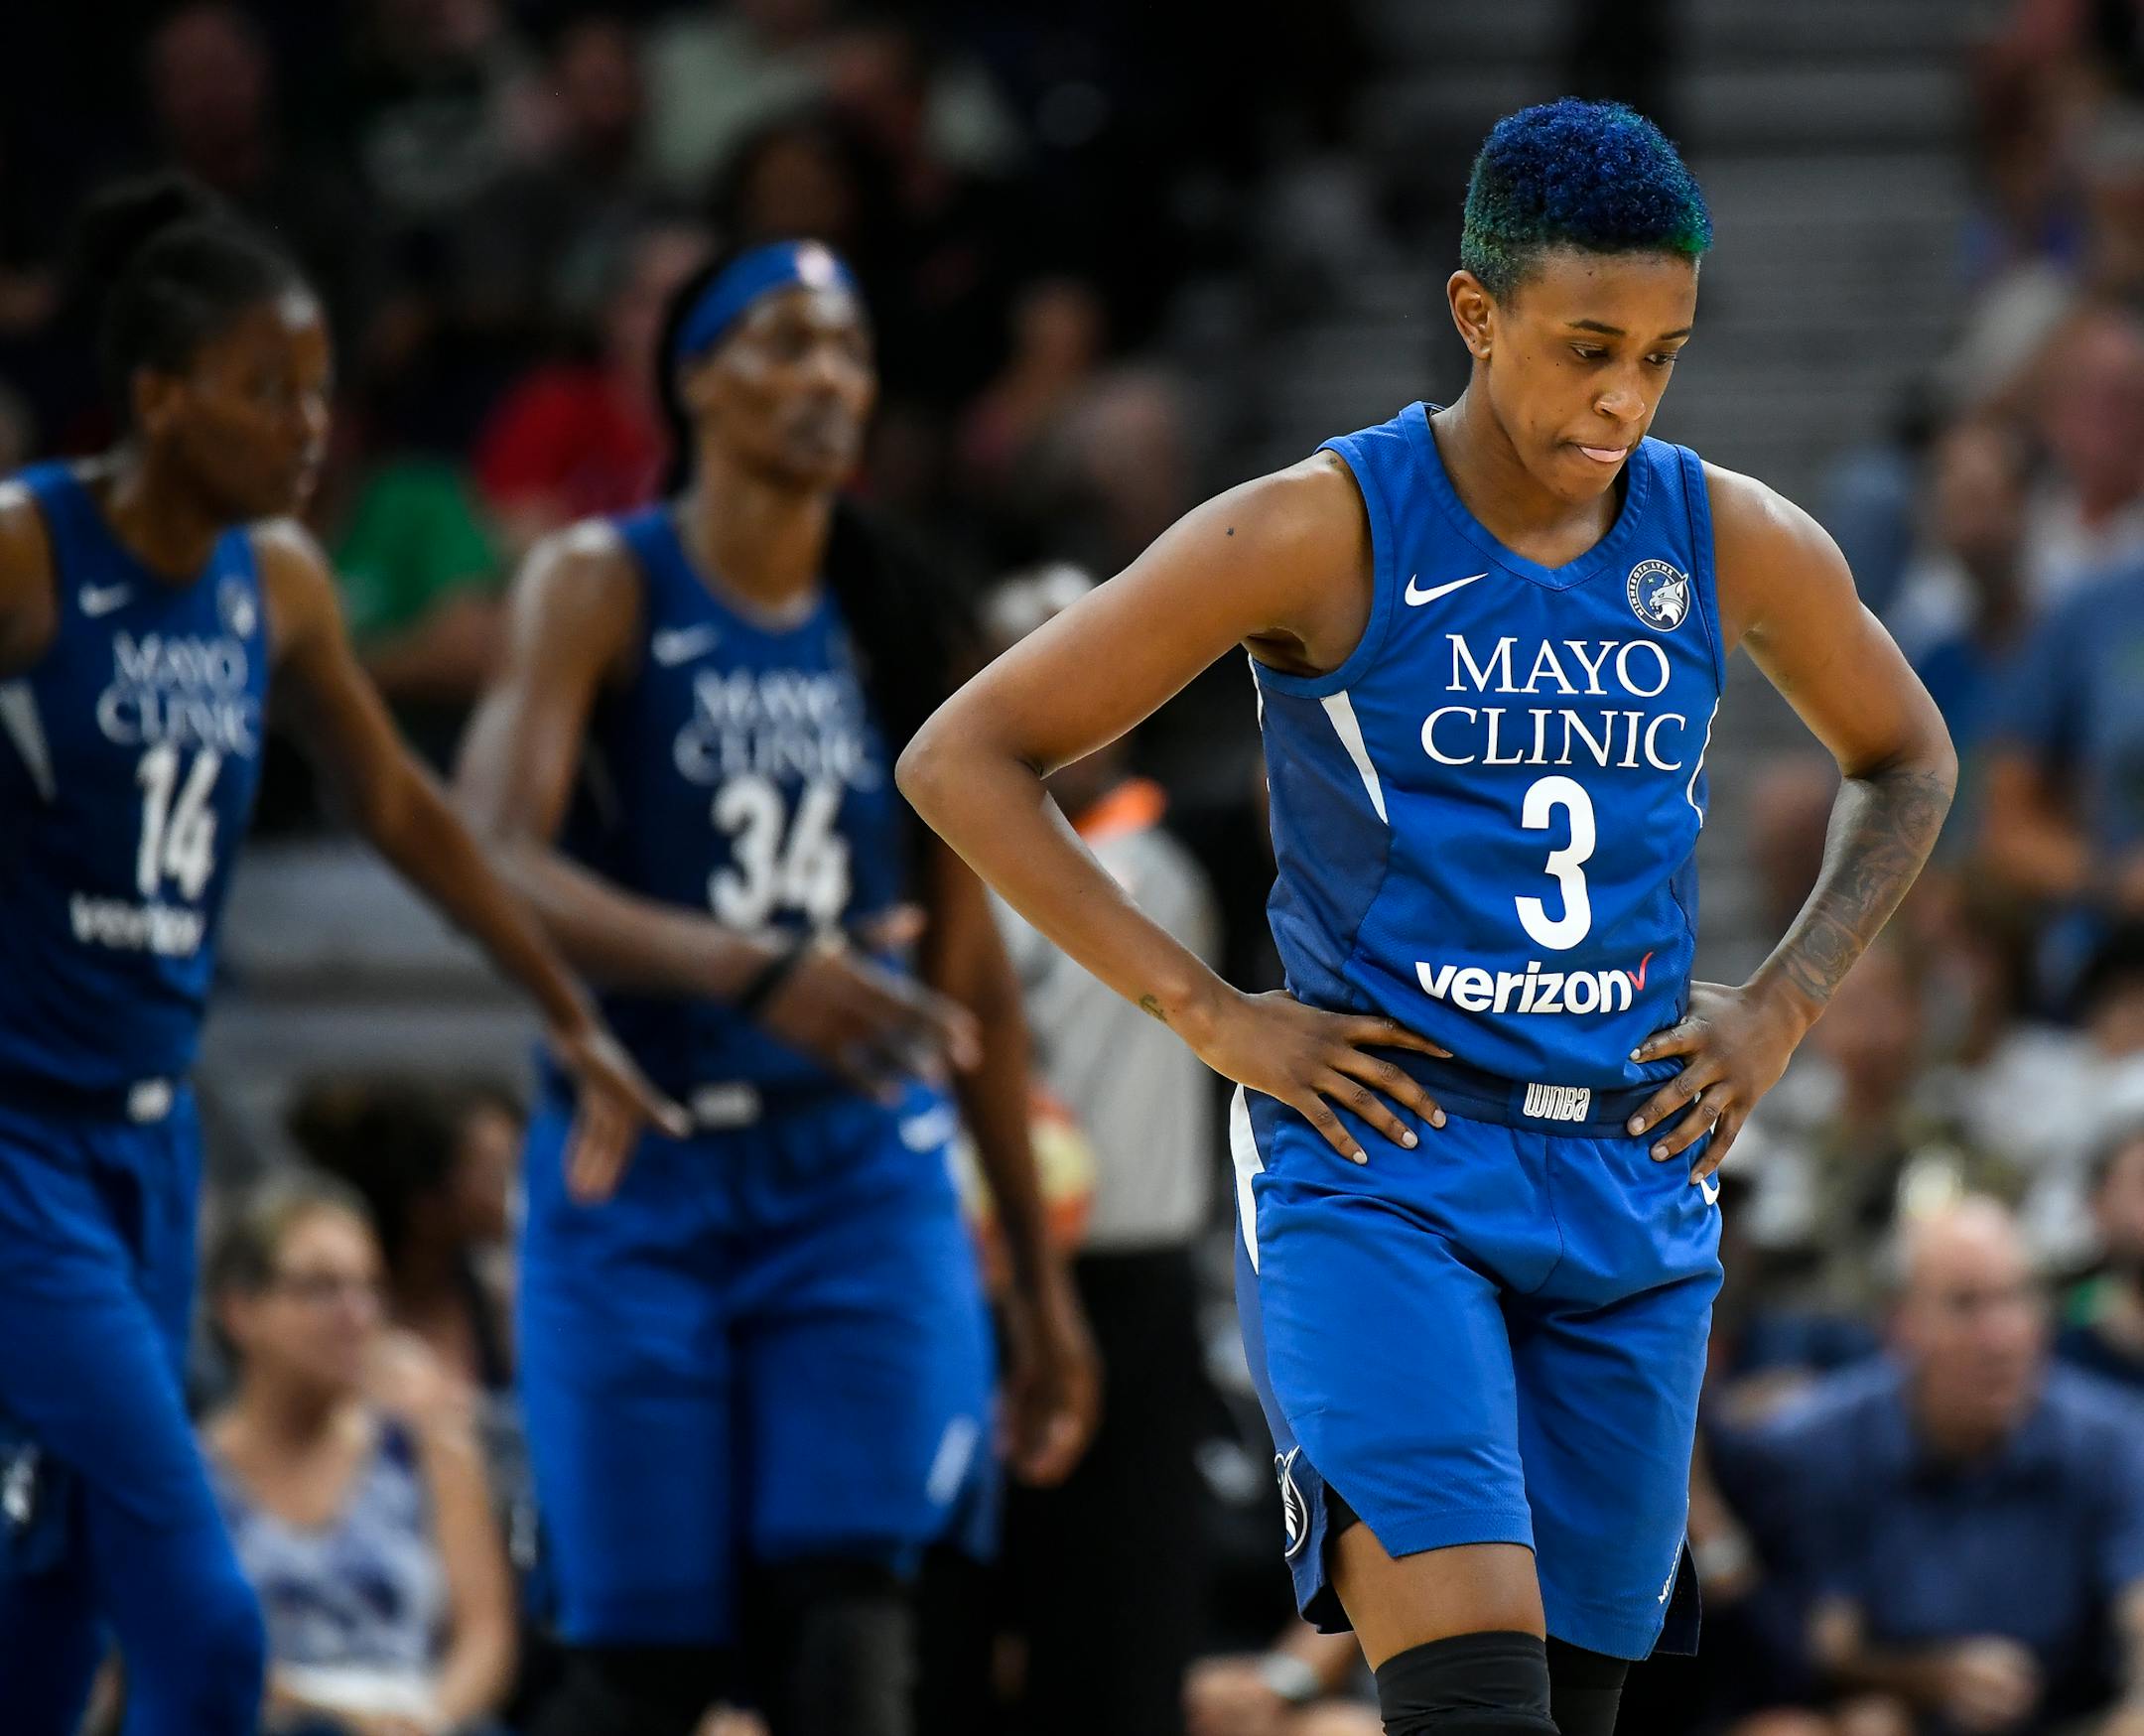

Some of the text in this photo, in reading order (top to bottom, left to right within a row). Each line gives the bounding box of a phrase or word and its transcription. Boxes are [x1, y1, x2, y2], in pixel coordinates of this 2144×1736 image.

[1628, 562, 1674, 616] MINNESOTA LYNX
[1444, 633, 1672, 698] MAYO
[1420, 707, 1686, 771] CLINIC
[135, 744, 219, 900] 14
[706, 773, 851, 931] 34
[1515, 775, 1596, 950] 3
[1414, 960, 1634, 1014] verizon
